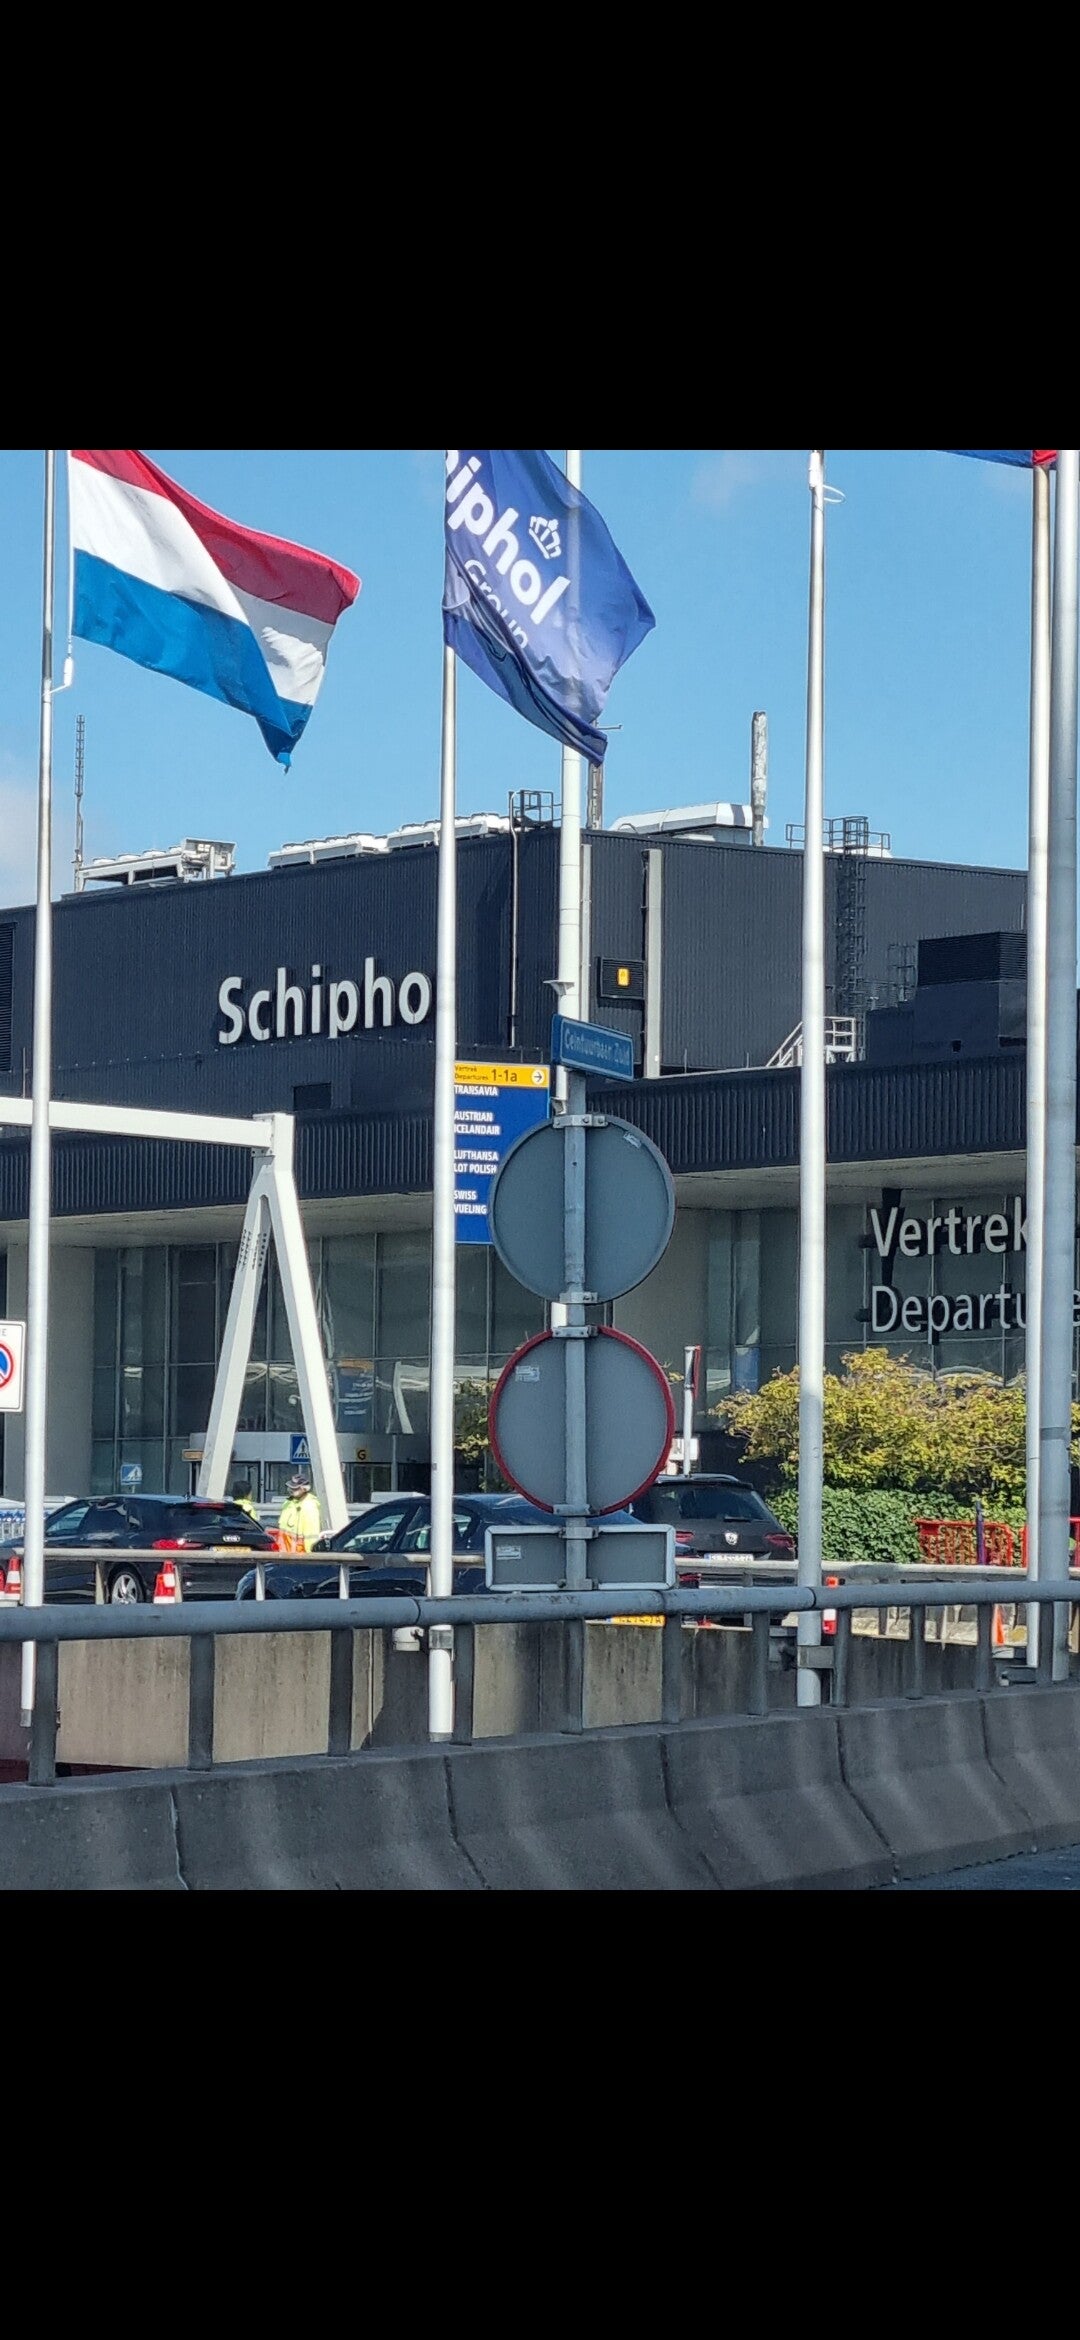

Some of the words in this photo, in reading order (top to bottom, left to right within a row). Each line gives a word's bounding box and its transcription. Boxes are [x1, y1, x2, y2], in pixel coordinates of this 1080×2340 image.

[446, 450, 571, 625] iphol
[218, 956, 432, 1045] Schipho
[491, 1068, 518, 1082] 1-1a
[454, 1085, 498, 1096] TRANSAVIA
[454, 1111, 493, 1122] AUSTRIAN
[454, 1124, 500, 1136] ICELANDAIR
[453, 1150, 499, 1161] LUFTHANSA
[453, 1163, 468, 1173] LOT
[469, 1163, 498, 1175] POLISH
[453, 1190, 477, 1200] SWISS
[453, 1203, 488, 1215] VUELING
[870, 1196, 1027, 1258] Vertrek
